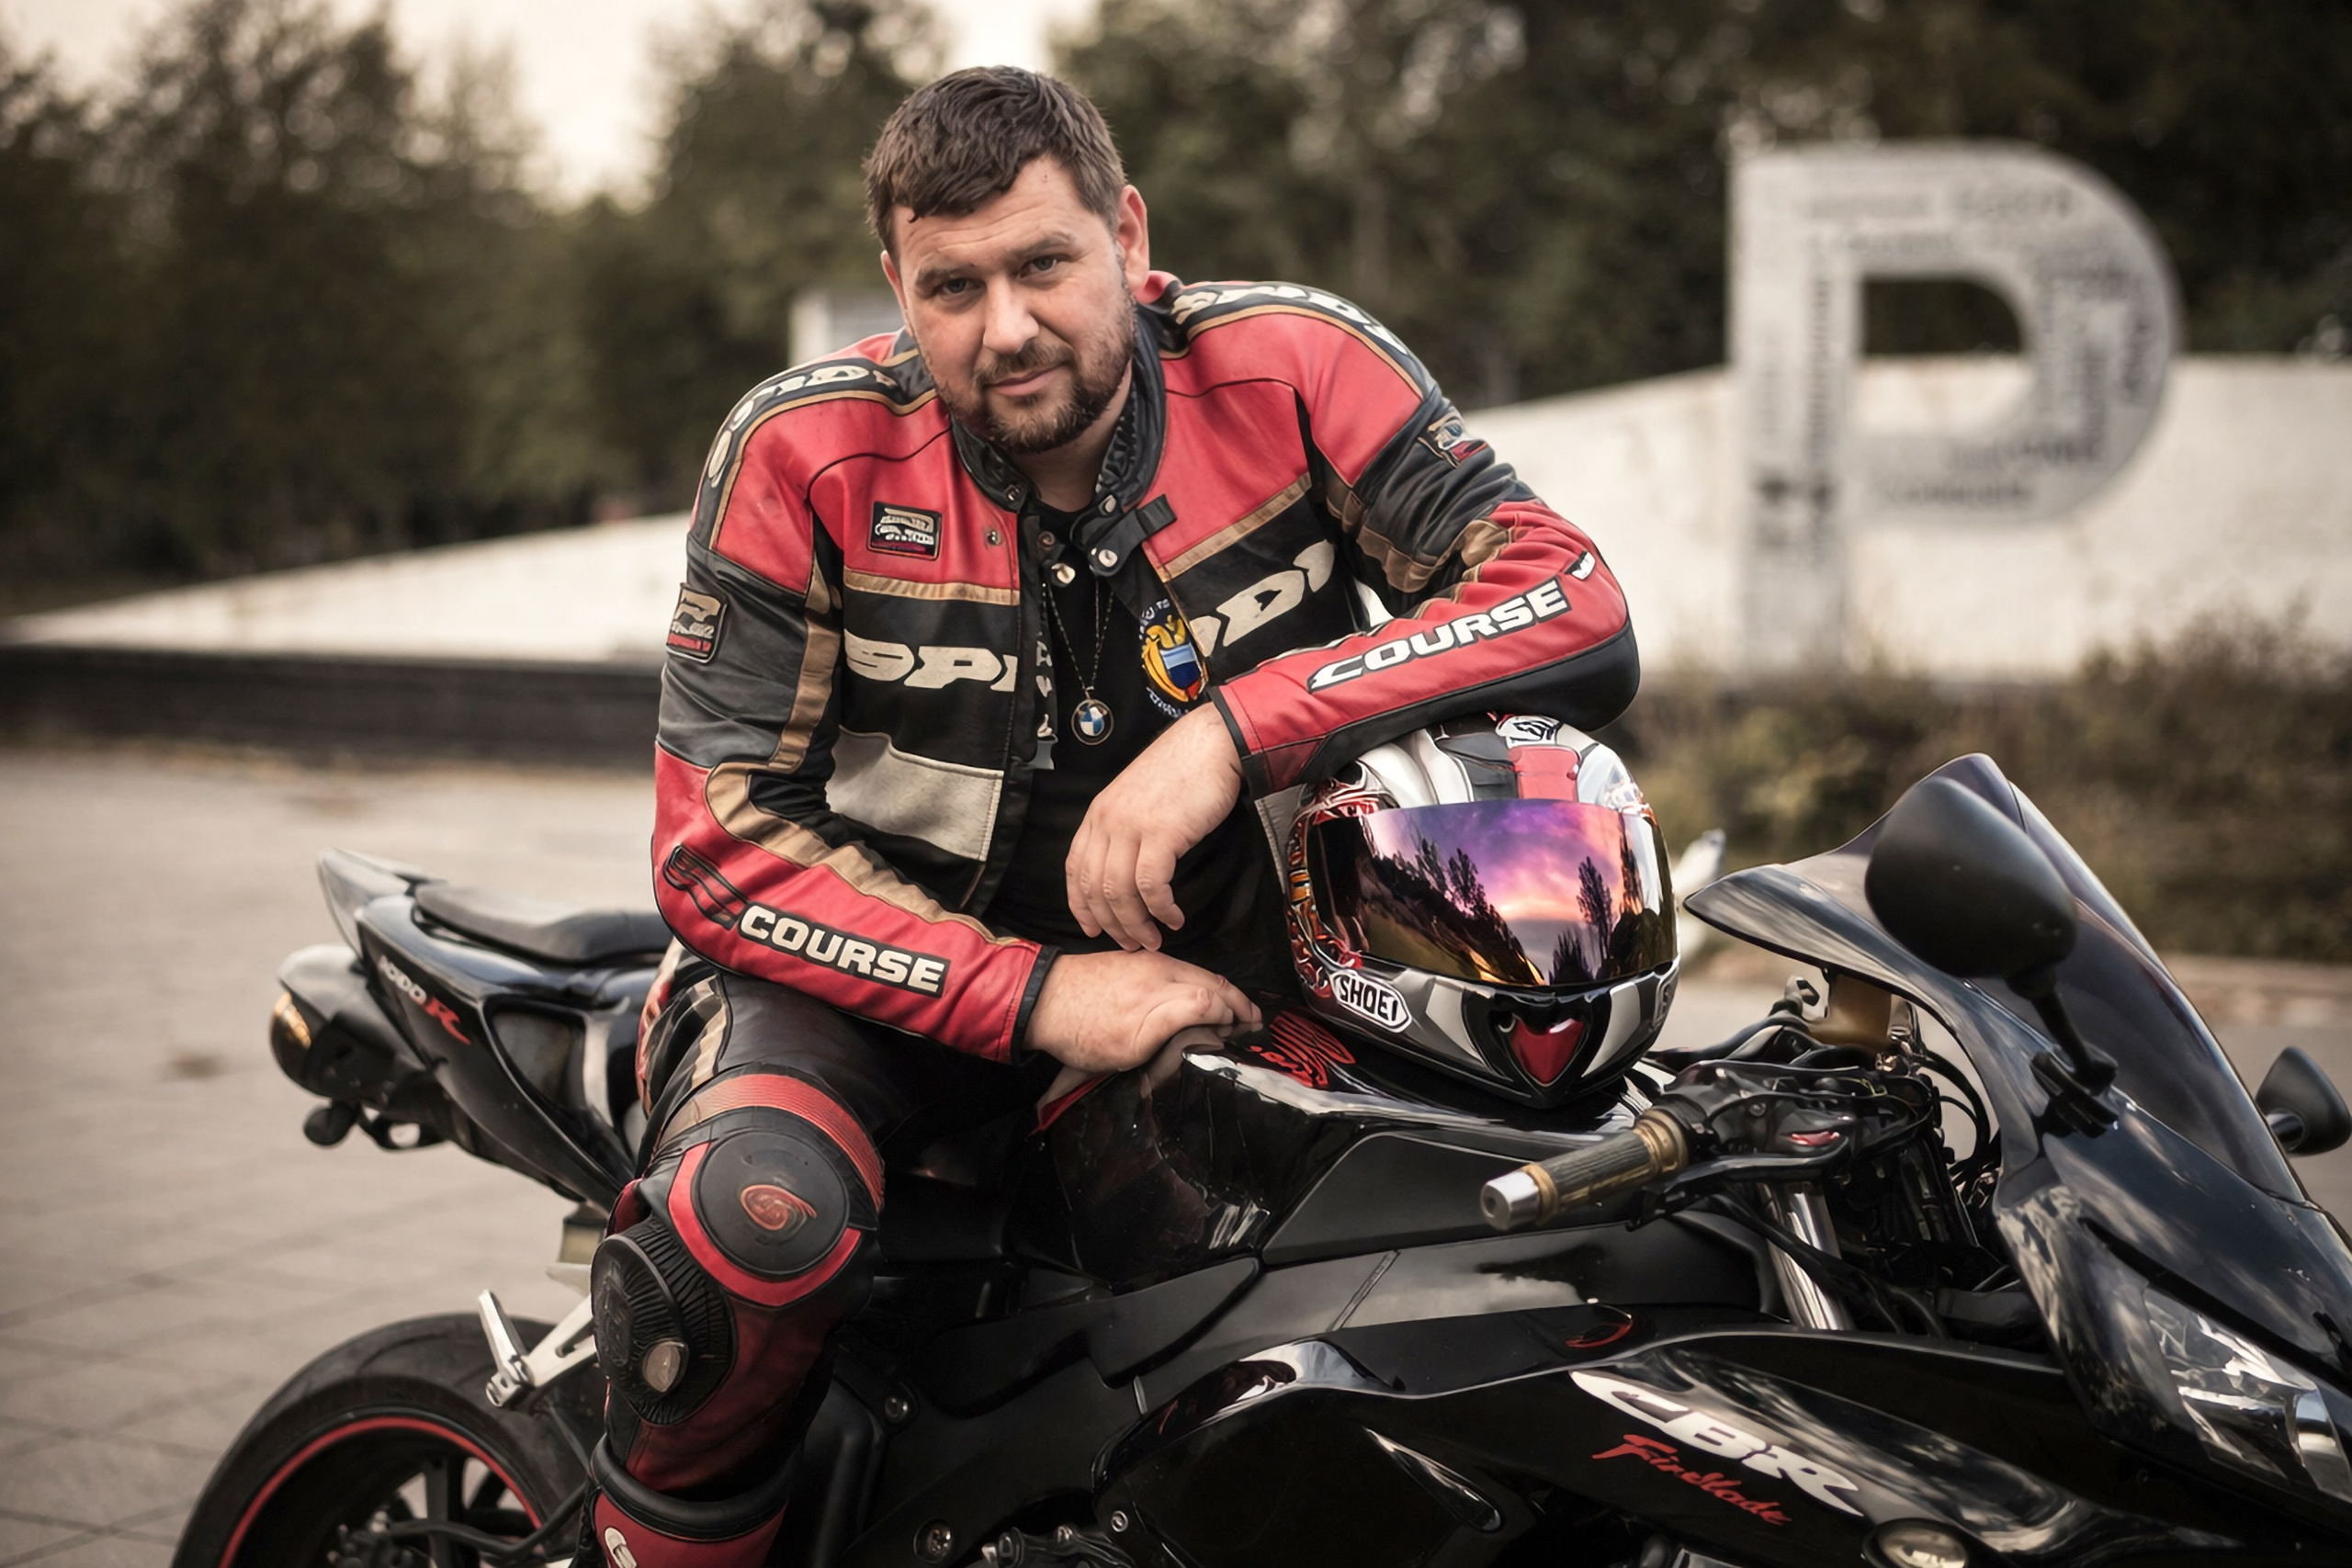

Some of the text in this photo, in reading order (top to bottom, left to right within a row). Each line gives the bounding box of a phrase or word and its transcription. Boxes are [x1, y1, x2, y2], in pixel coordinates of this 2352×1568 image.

[1310, 581, 1566, 691] COURSE
[741, 905, 945, 993] COURSE
[1338, 974, 1397, 1021] SHOEI
[1569, 1371, 1864, 1517] CBR
